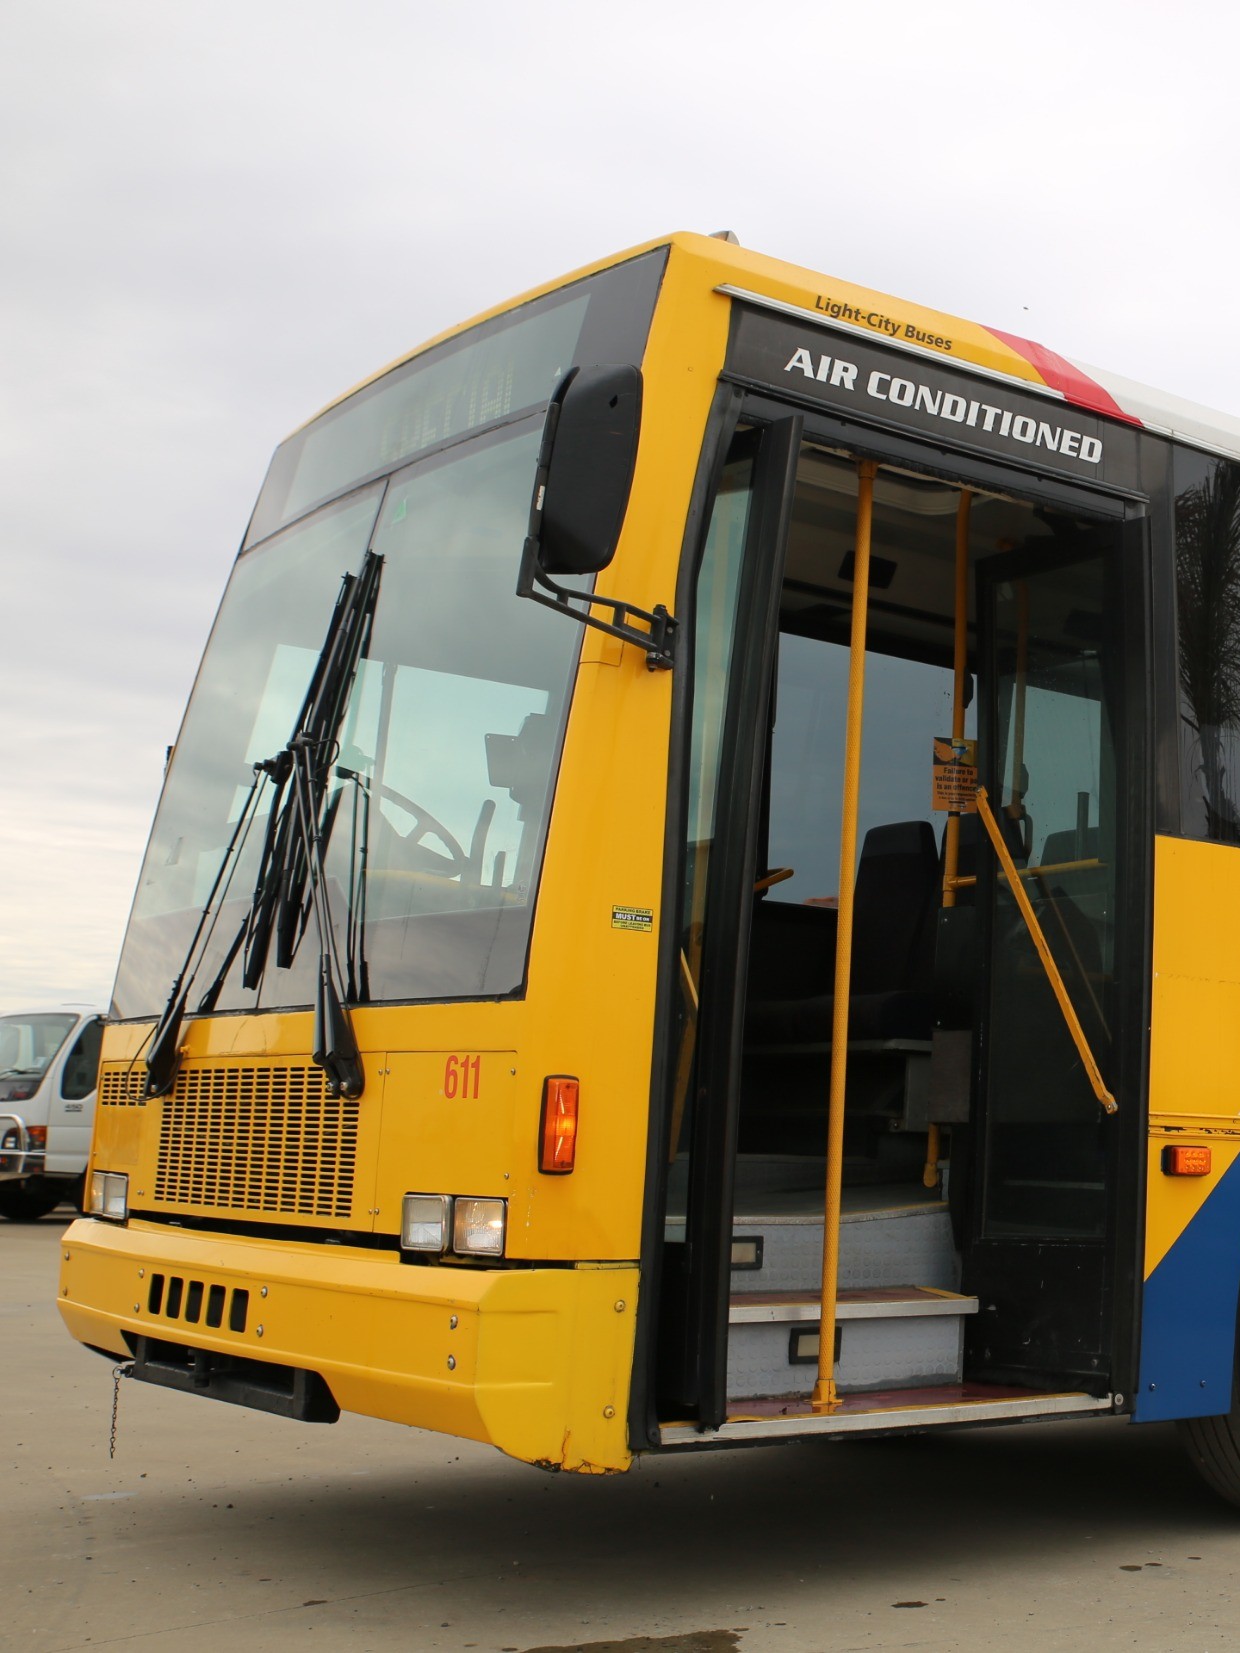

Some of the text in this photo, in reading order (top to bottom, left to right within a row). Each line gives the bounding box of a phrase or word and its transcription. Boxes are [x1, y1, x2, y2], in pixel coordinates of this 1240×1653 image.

[815, 295, 953, 351] Light-City Buses
[784, 347, 1103, 464] AIR CONDITIONED
[944, 767, 966, 775] Failure
[935, 775, 961, 783] validate
[936, 782, 942, 790] is
[615, 913, 636, 921] MUST
[444, 1054, 481, 1100] 611
